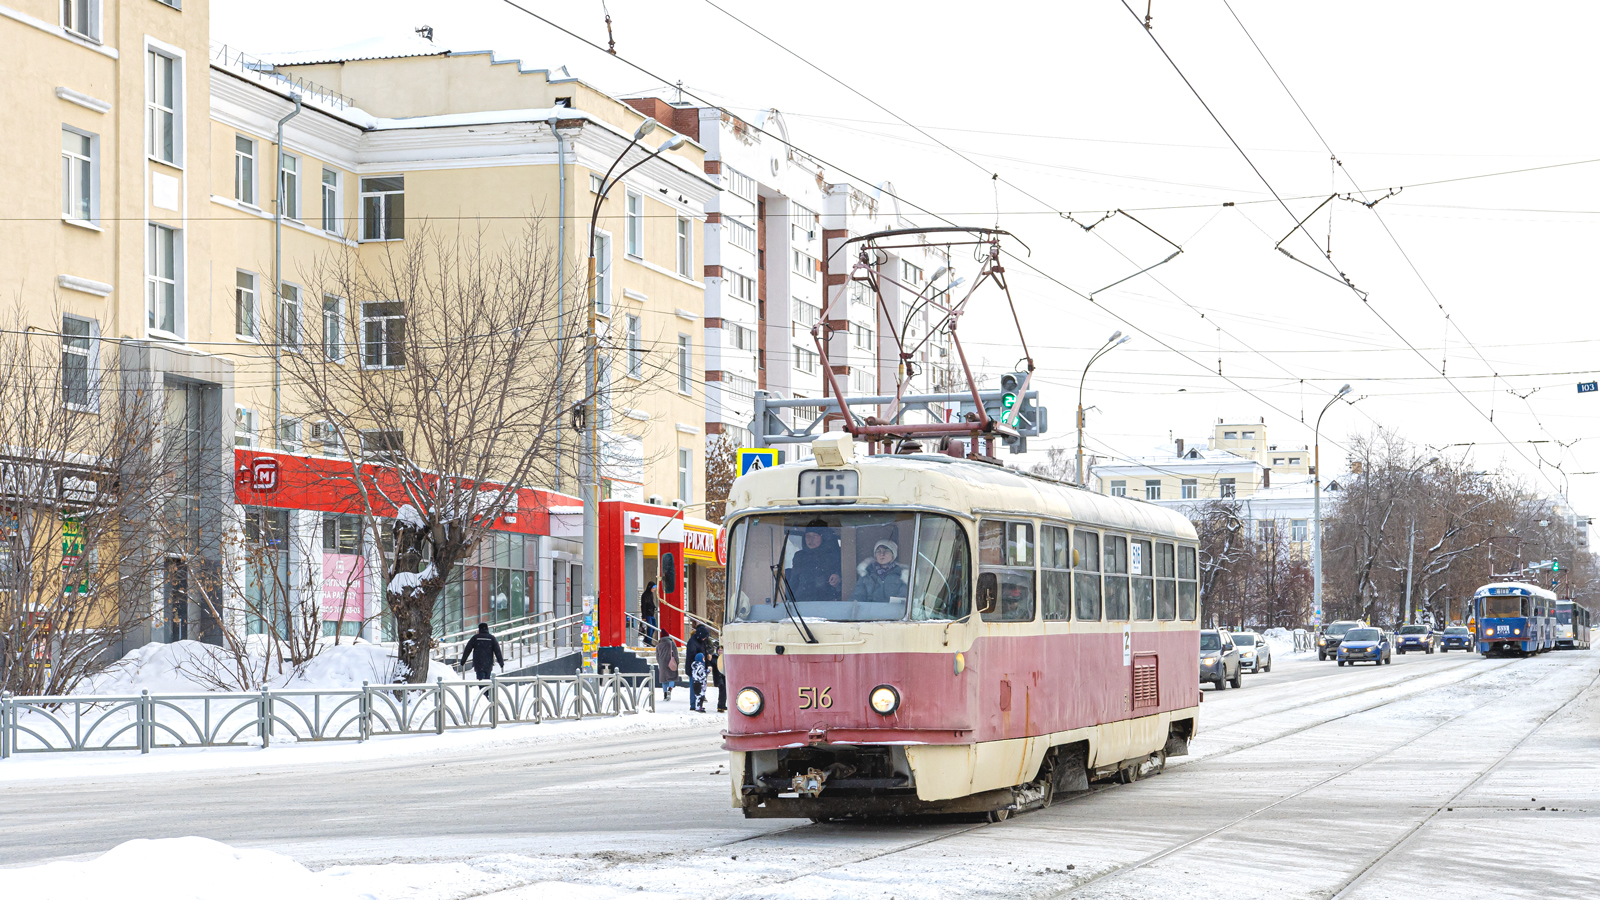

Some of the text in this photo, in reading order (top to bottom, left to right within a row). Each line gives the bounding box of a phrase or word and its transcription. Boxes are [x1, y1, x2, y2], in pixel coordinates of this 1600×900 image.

[811, 474, 844, 501] 15
[1132, 546, 1140, 565] 516
[798, 686, 834, 710] 516
